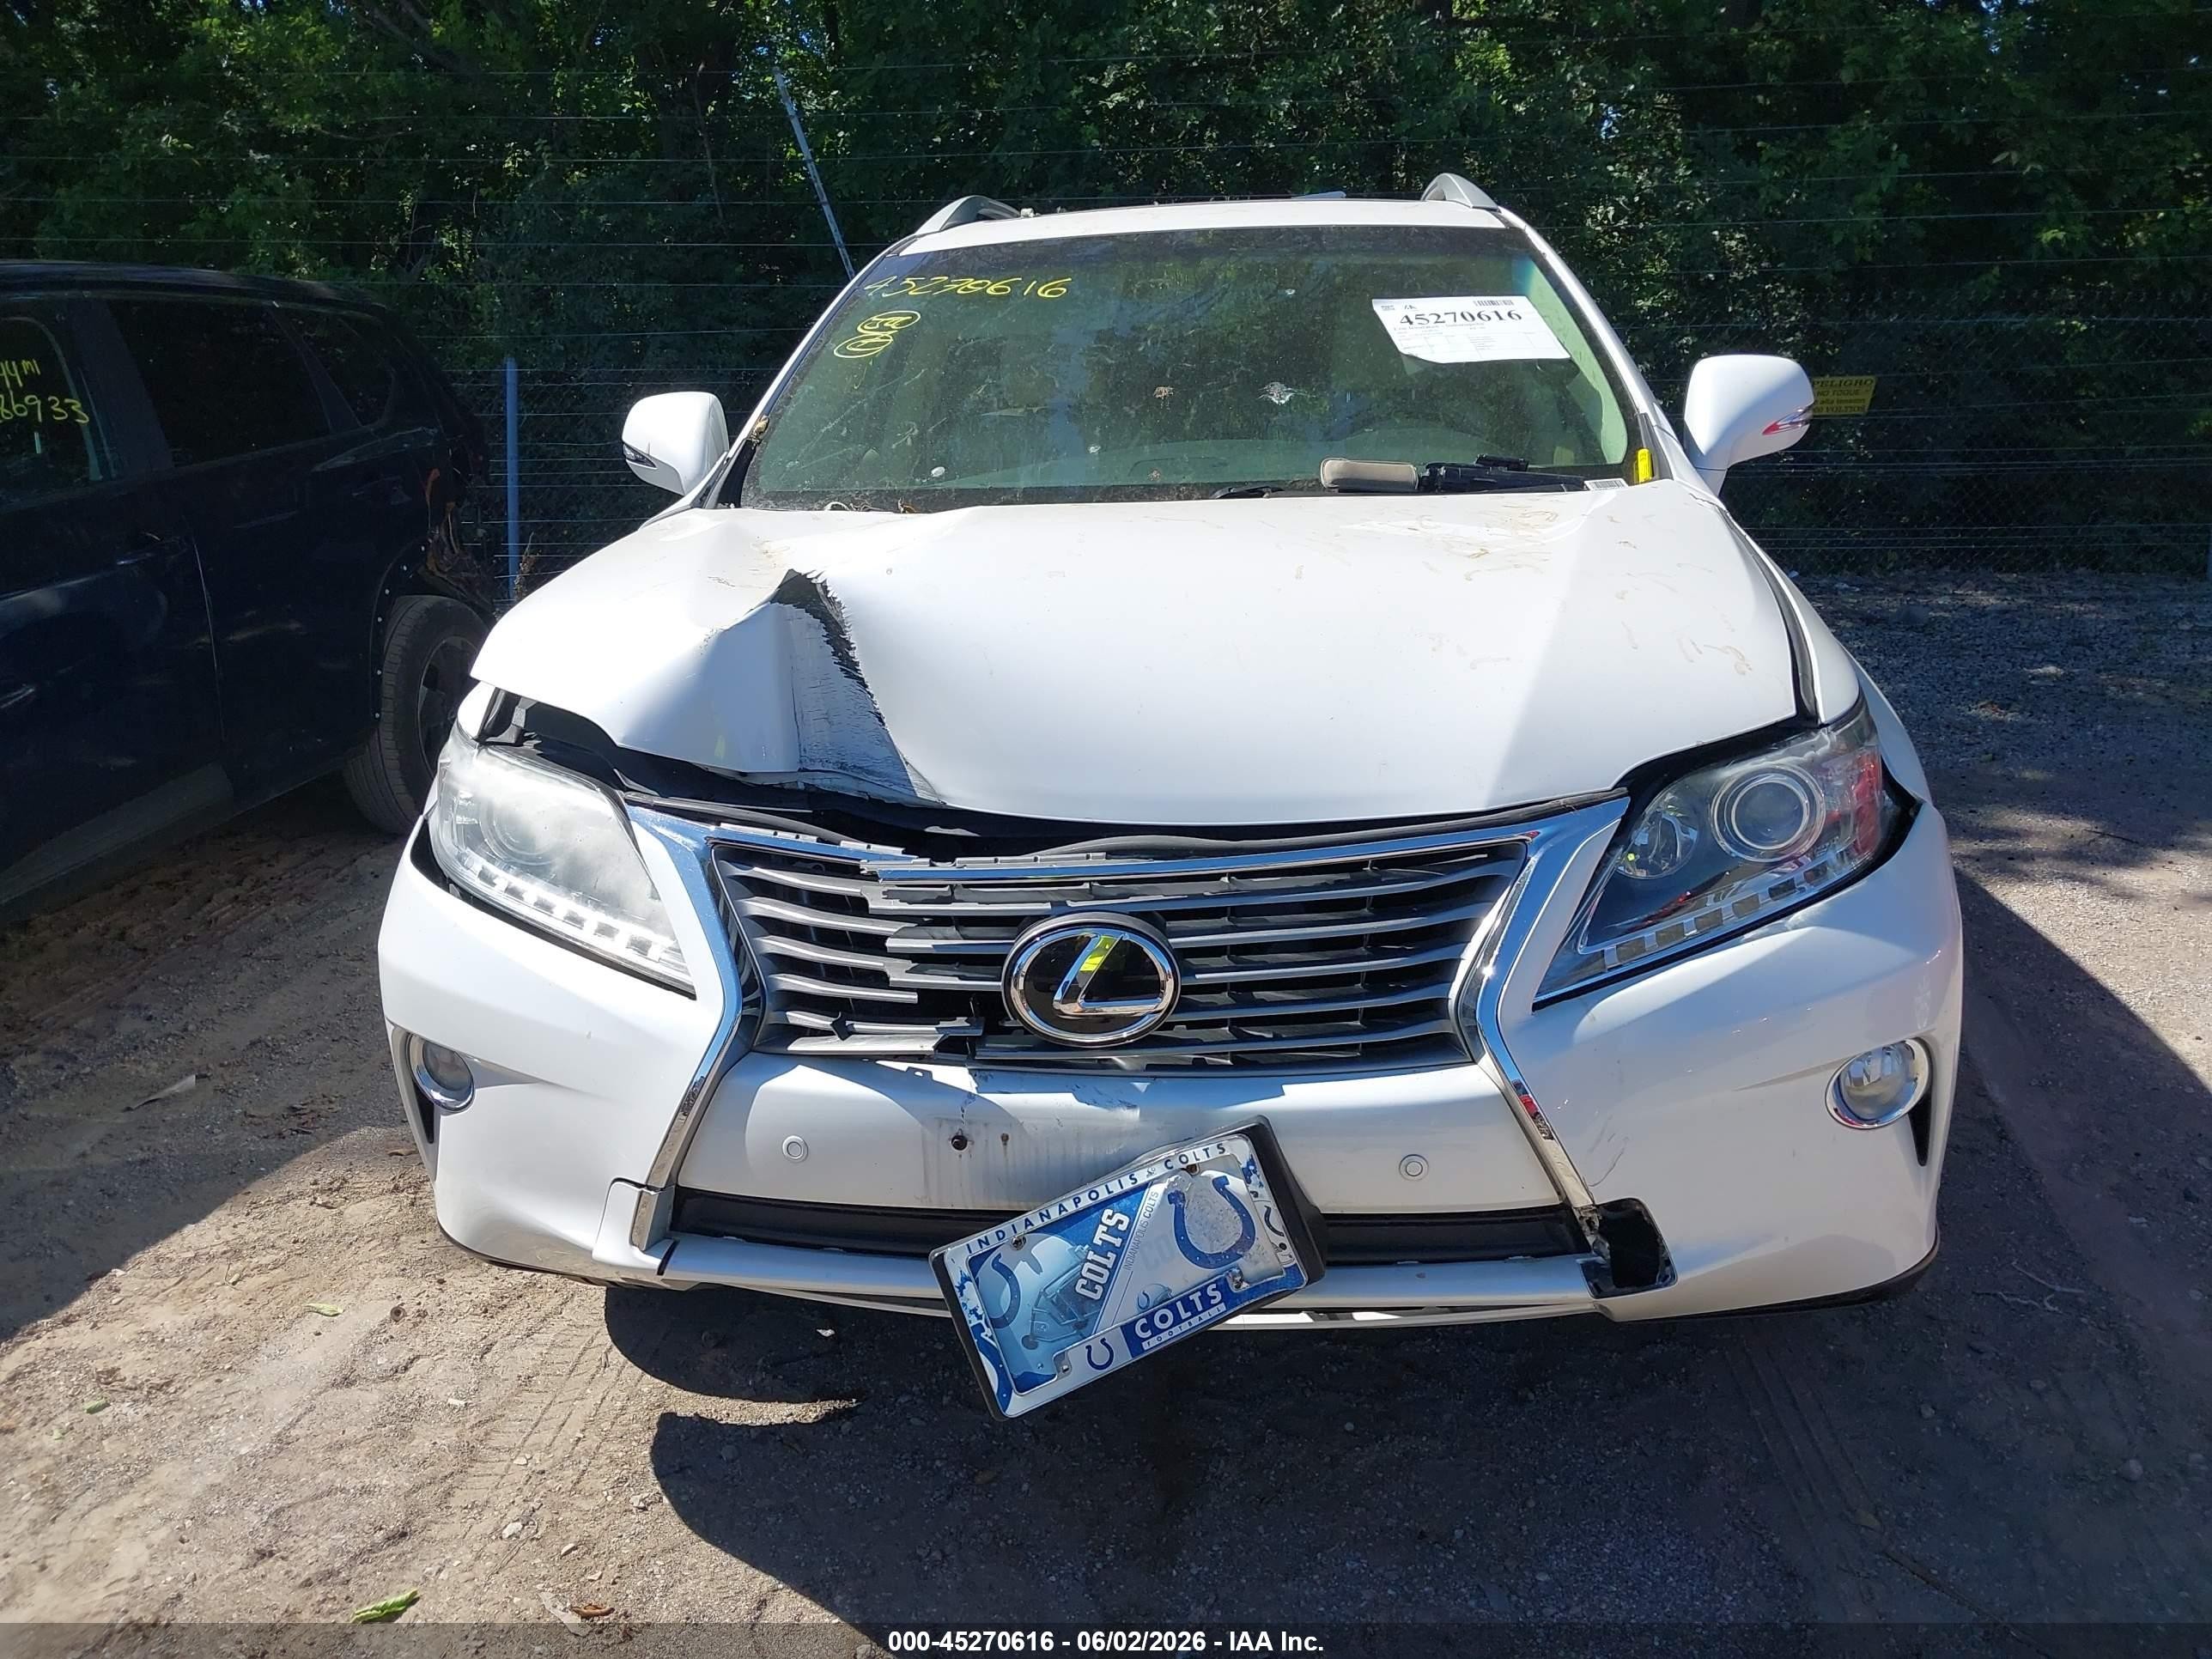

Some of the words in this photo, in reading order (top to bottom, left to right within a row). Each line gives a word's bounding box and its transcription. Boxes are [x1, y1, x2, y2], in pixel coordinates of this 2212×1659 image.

[863, 275, 1073, 298] 45270616
[1399, 309, 1522, 325] 45270616
[966, 1173, 1138, 1254] INDIANAPOLIS
[1164, 1143, 1226, 1170] COLTS
[1074, 1208, 1130, 1300] COLTS
[1123, 1219, 1149, 1271] INDIANAPOLIS
[1143, 1191, 1159, 1219] COLTS
[1134, 1283, 1222, 1339] COLTS
[1146, 1307, 1221, 1347] FOOTBALL
